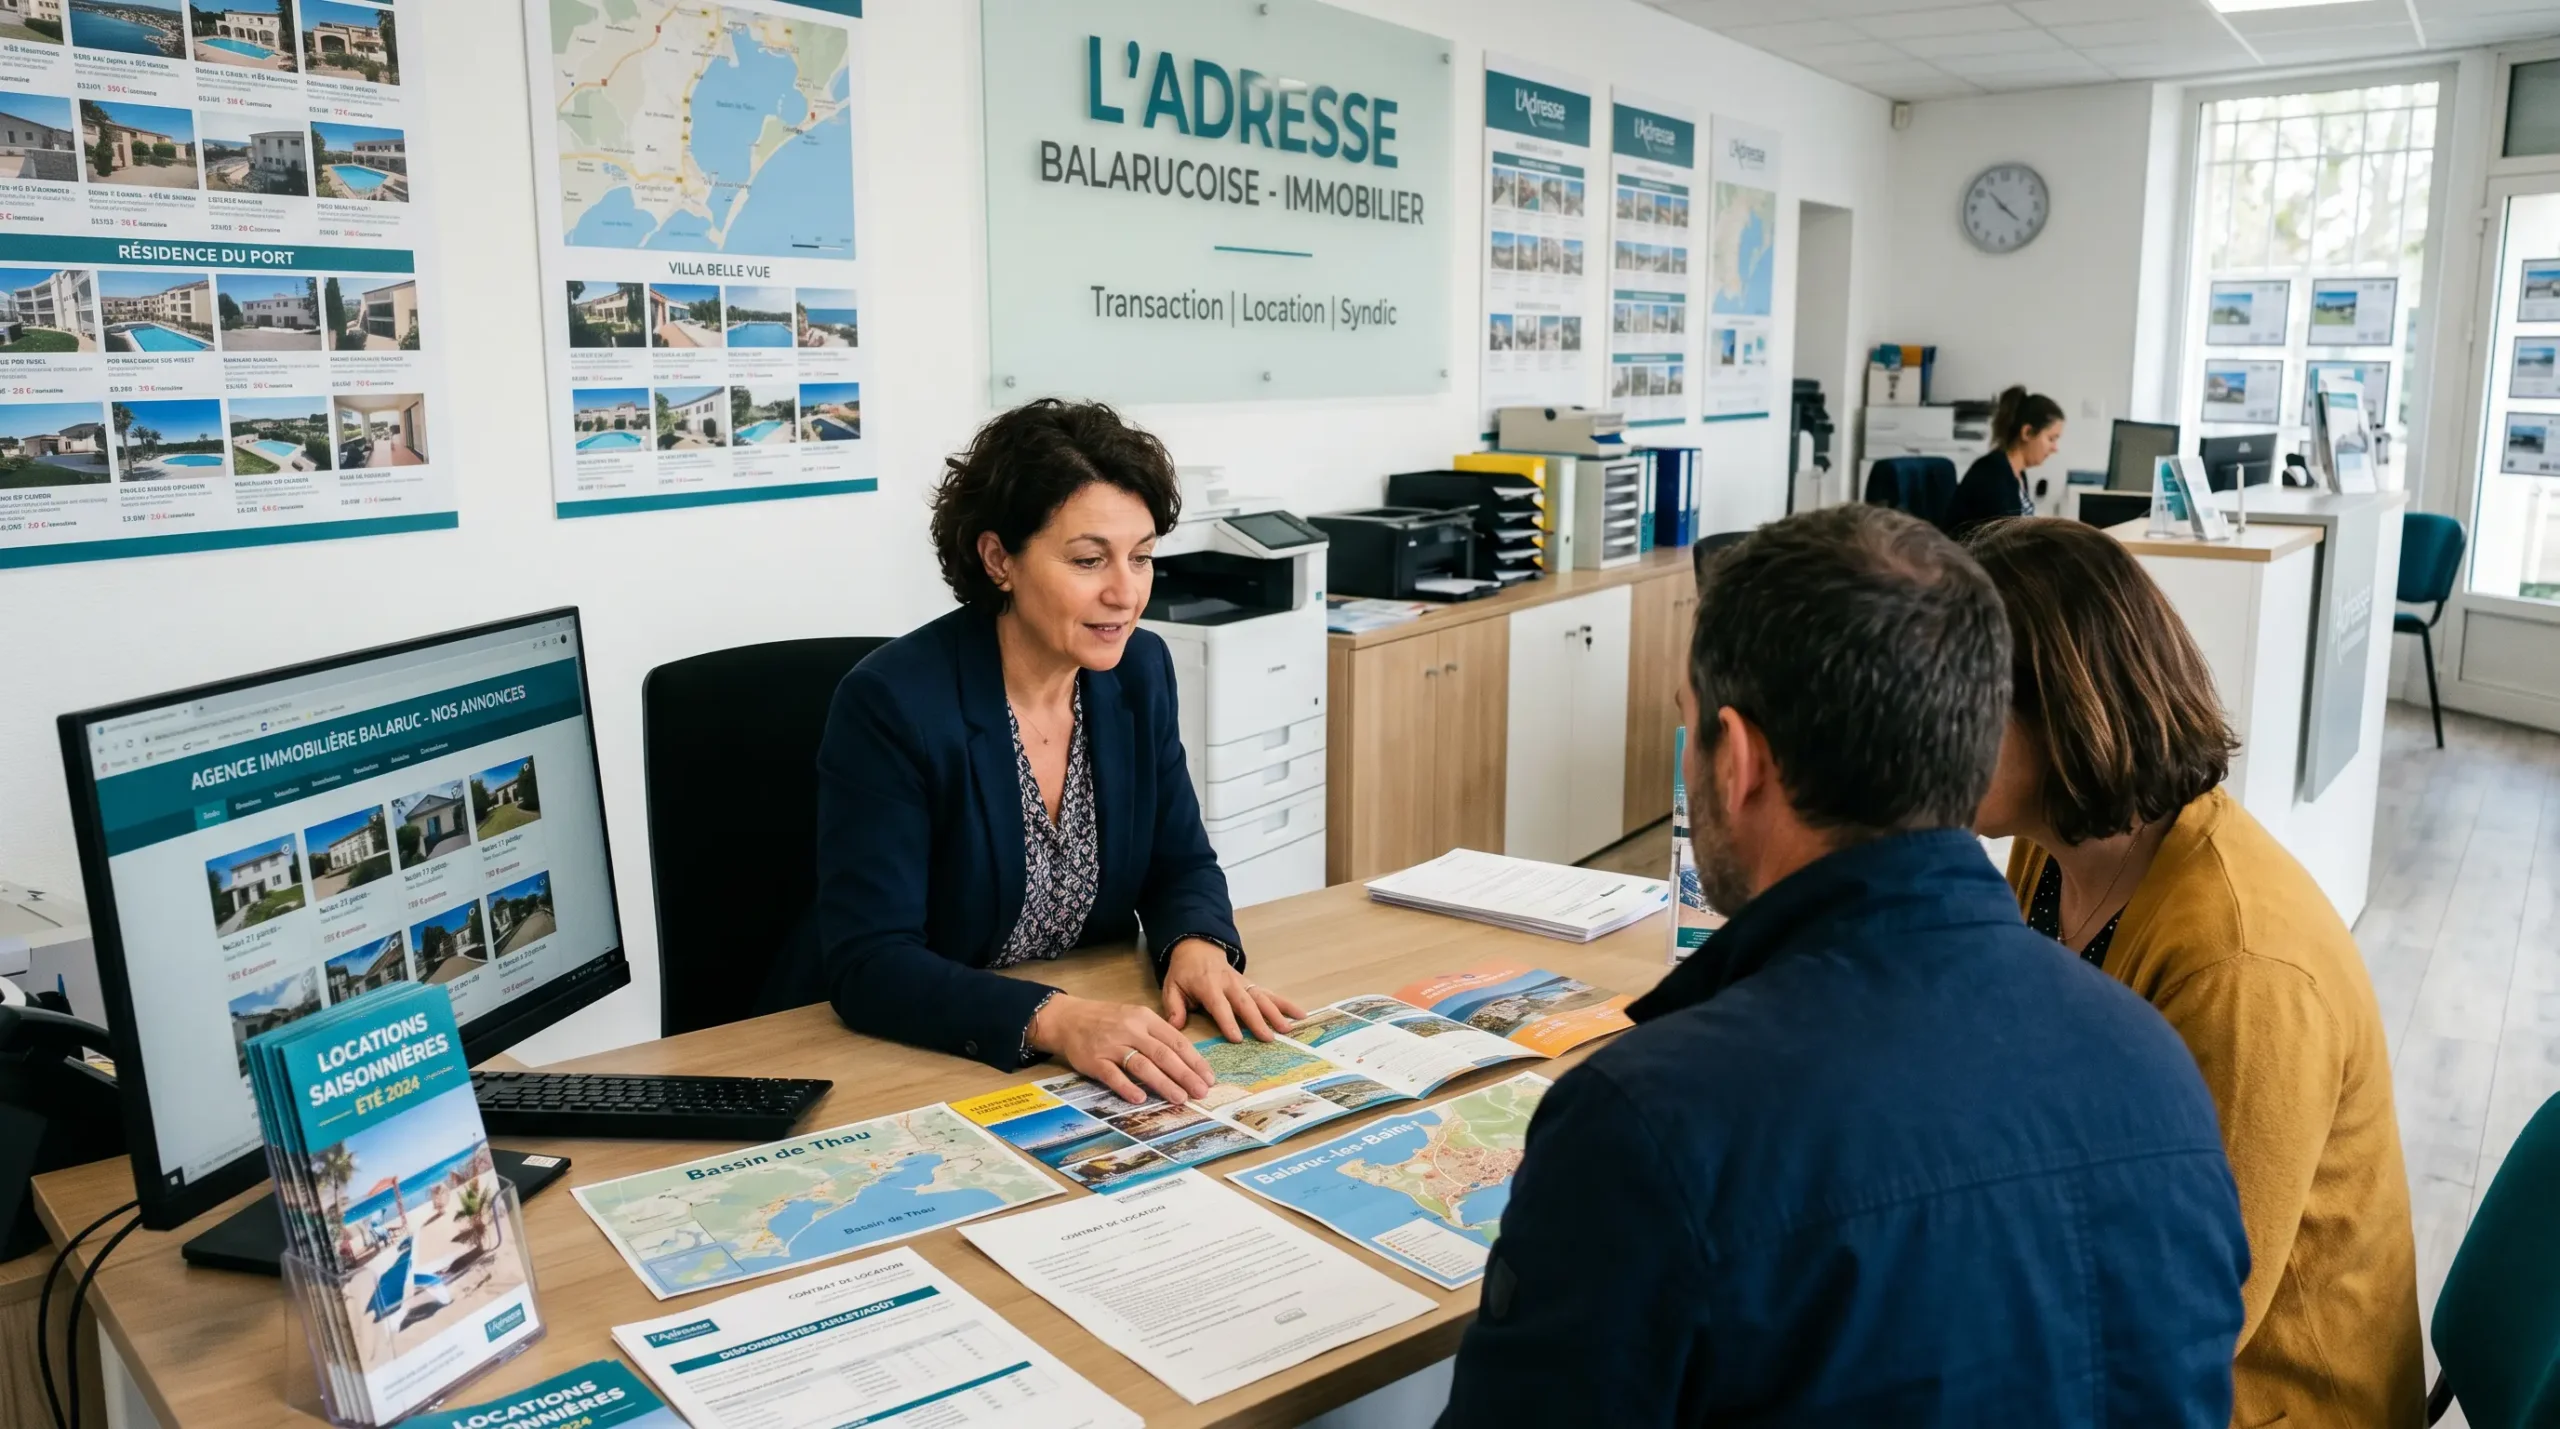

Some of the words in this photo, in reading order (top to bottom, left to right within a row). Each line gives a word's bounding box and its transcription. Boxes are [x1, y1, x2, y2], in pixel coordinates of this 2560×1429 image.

[1088, 34, 1399, 170] L'ADRESSE
[1040, 140, 1260, 206] BALARUCOISE
[1285, 174, 1424, 225] IMMOBILIER
[118, 240, 218, 262] RÉSIDENCE
[221, 248, 246, 263] DU
[250, 249, 295, 265] PORT
[668, 261, 704, 276] VILLA
[707, 263, 744, 278] BELLE
[746, 264, 771, 279] VUE
[1090, 285, 1224, 321] Transaction
[1242, 293, 1326, 325] Location
[1340, 298, 1398, 331] Syndic
[191, 757, 258, 791] AGENCE
[359, 712, 422, 743] BALARUC
[431, 704, 459, 725] NOS
[460, 685, 526, 716] ANNONCES
[317, 1012, 428, 1073] LOCATIONS
[309, 1033, 449, 1107] SAISONNIÈRES
[385, 1075, 420, 1103] 2024
[686, 1152, 769, 1181] Bassin
[775, 1146, 806, 1160] de
[808, 1130, 872, 1151] Thau
[887, 1214, 904, 1224] de
[904, 1206, 936, 1219] Thau
[452, 1380, 598, 1429] LOCATIONS
[486, 1386, 626, 1429] ONNIÈRES
